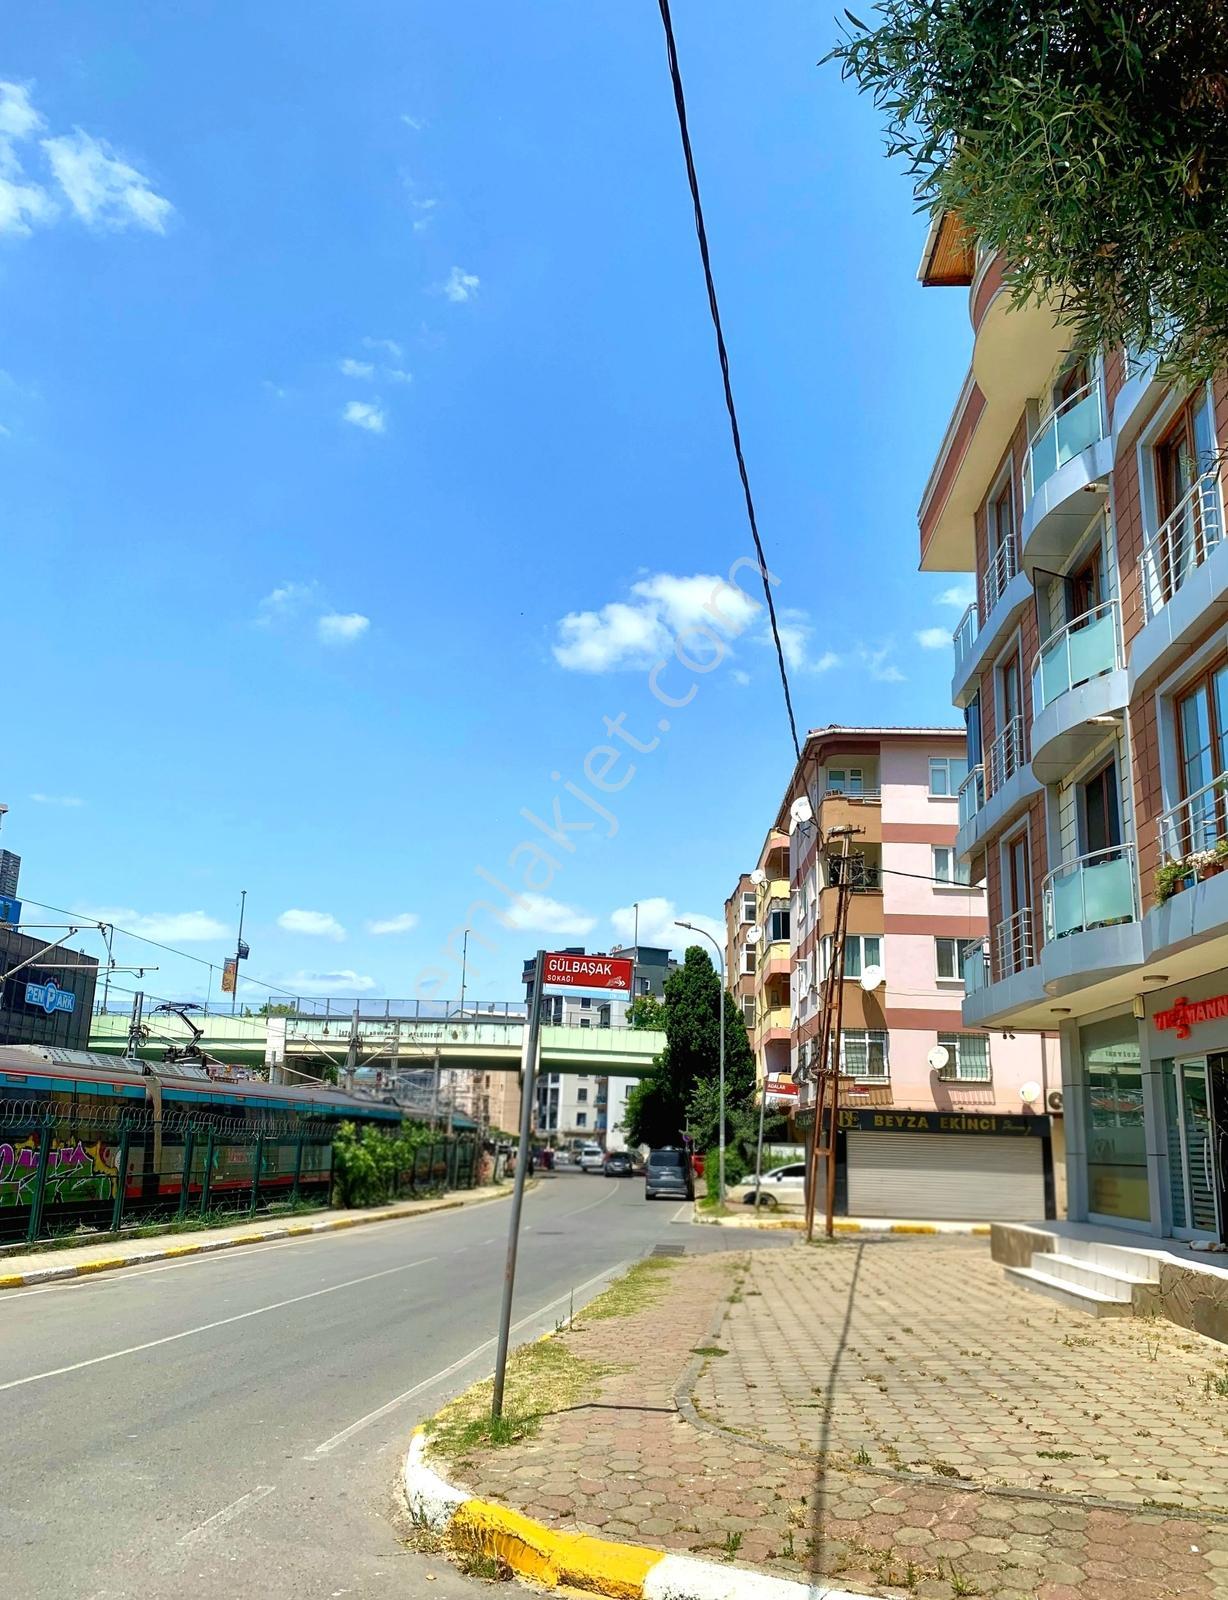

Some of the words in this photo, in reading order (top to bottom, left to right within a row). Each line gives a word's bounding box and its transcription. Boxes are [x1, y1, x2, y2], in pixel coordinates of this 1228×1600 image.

[549, 958, 612, 976] GÜLBAŞAK
[547, 974, 574, 983] SOKAĞI
[874, 1115, 929, 1129] BEYZA
[940, 1114, 997, 1131] EKİNCİ
